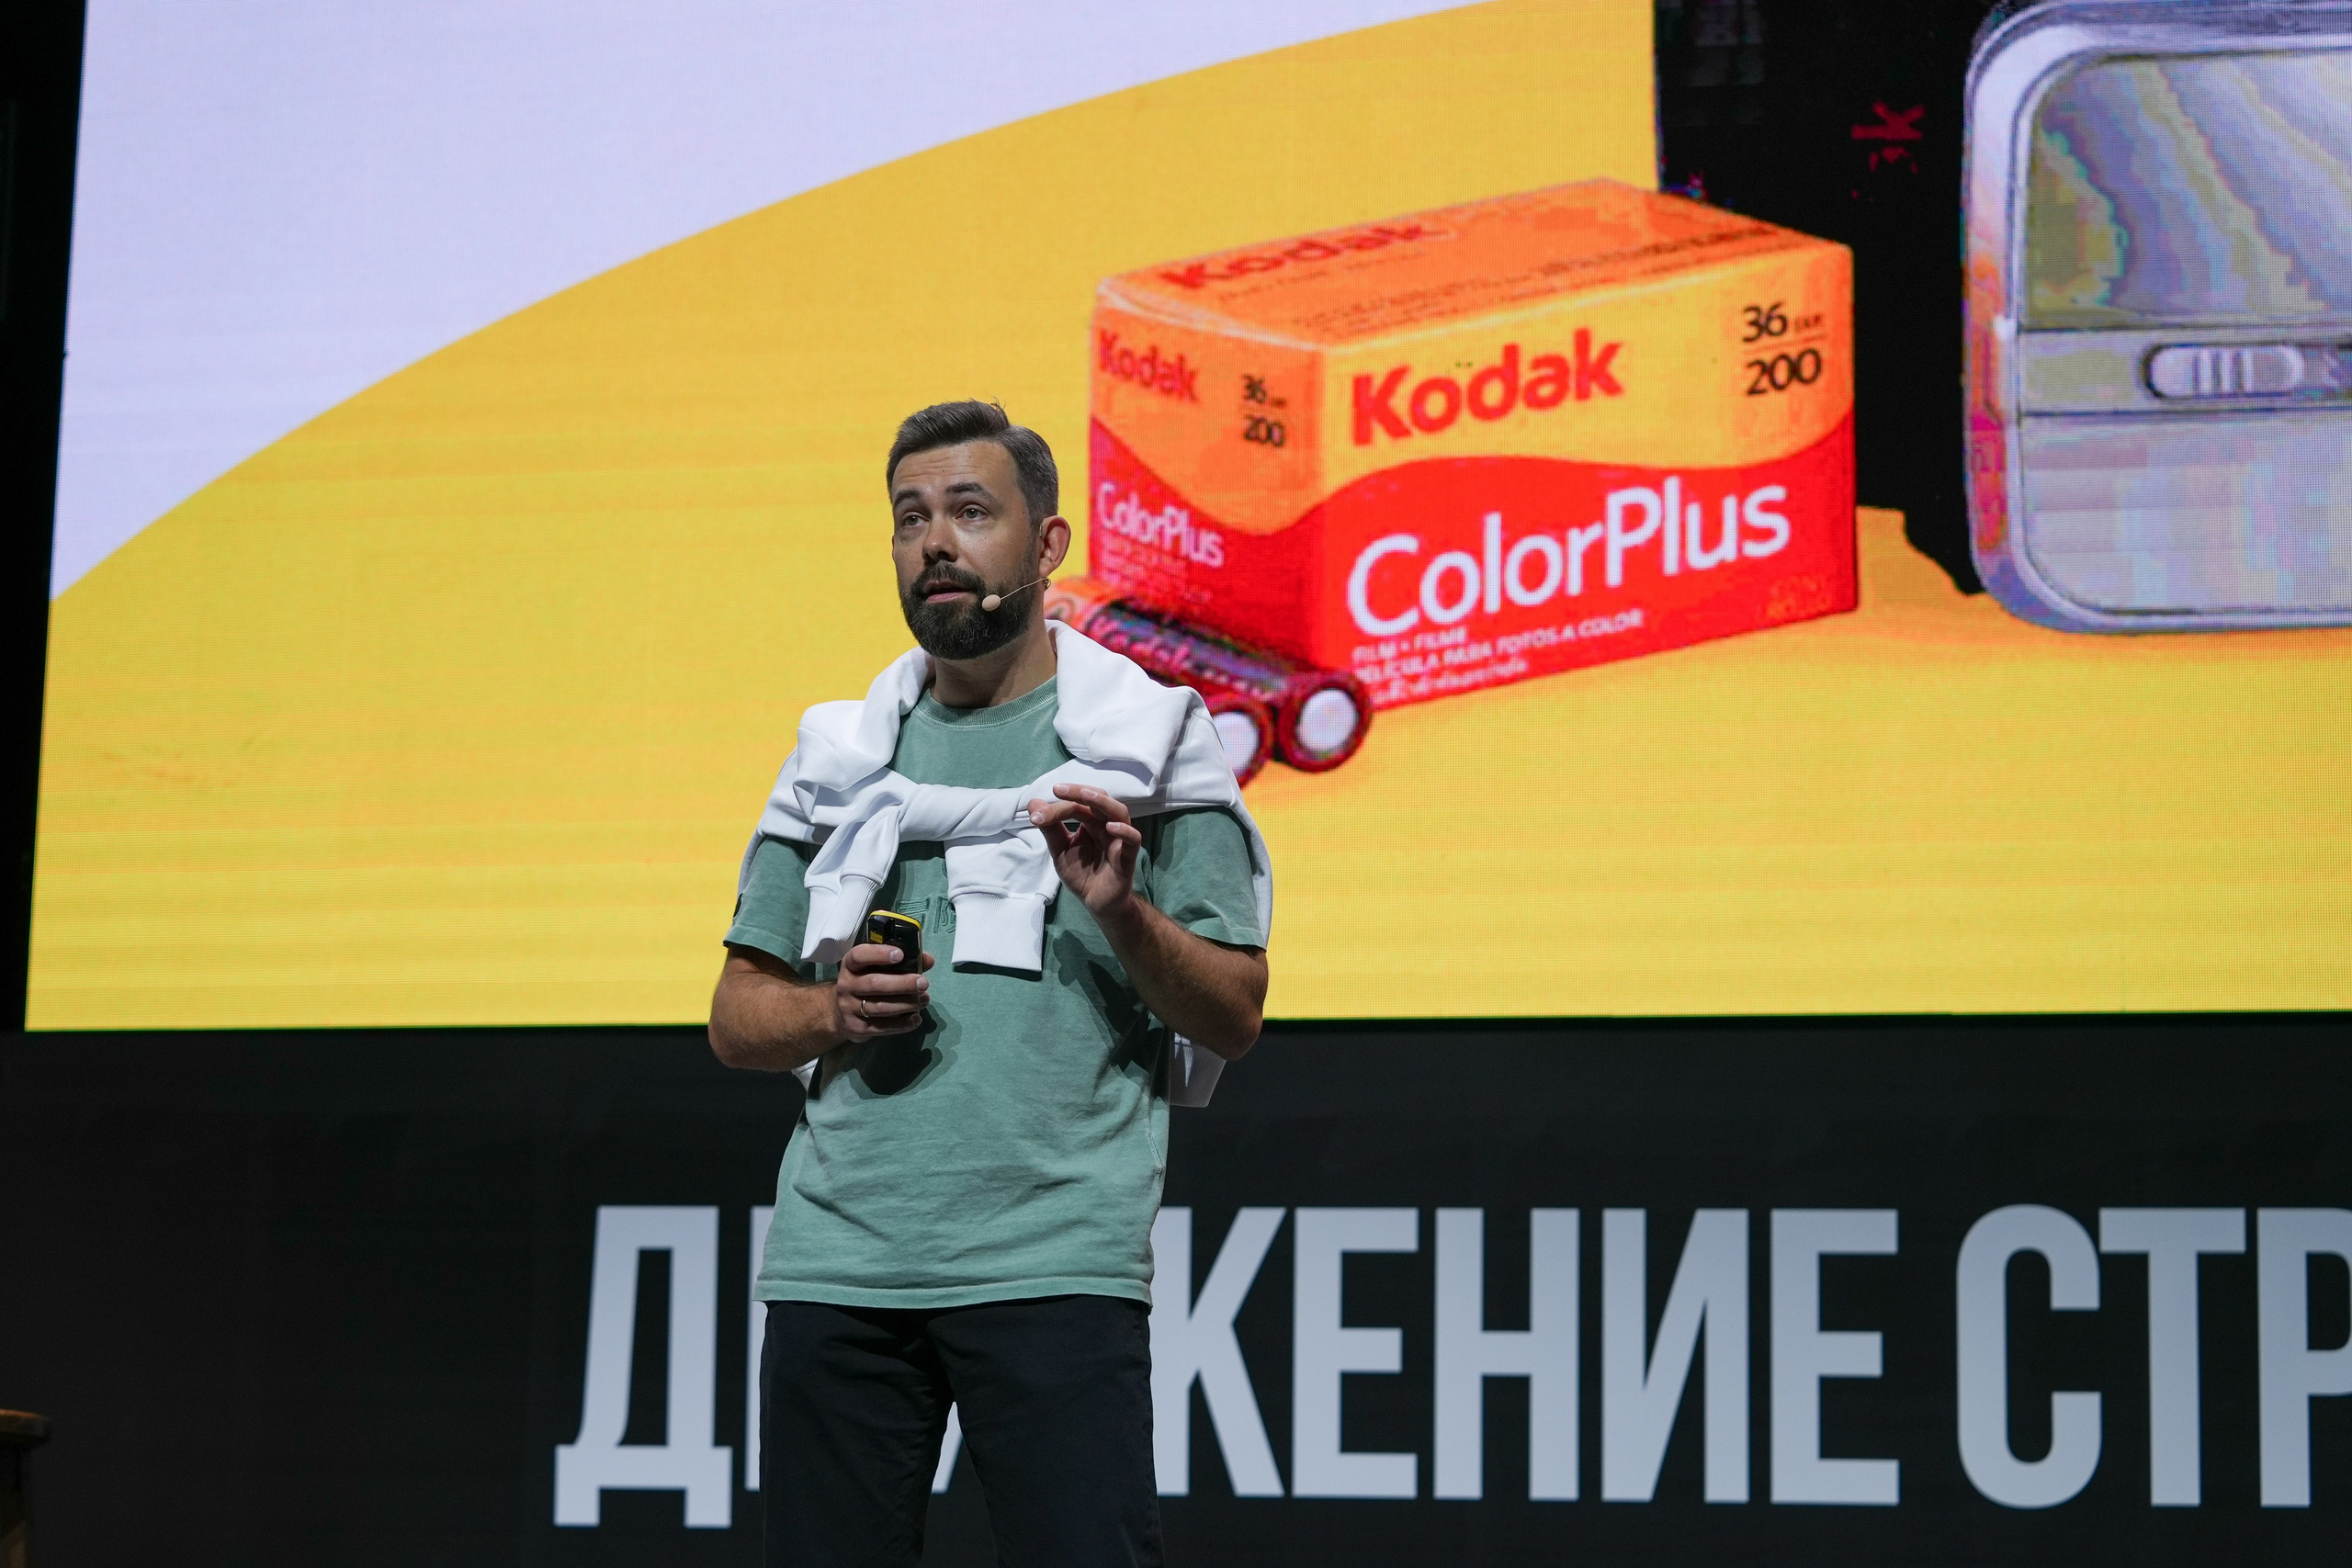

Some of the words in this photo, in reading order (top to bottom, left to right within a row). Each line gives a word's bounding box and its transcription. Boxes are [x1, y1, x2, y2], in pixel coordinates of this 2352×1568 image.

[1159, 223, 1448, 289] Kodak
[1741, 300, 1787, 344] 36
[1099, 328, 1199, 404] Kodak
[1242, 373, 1267, 404] 36
[1351, 327, 1625, 446] Kodak
[1746, 347, 1822, 395] 200
[1243, 414, 1285, 447] 200
[1096, 479, 1225, 568] ColorPlus
[1346, 475, 1792, 637] ColorPlus
[1352, 641, 1398, 665] FILM
[1413, 626, 1468, 649] FILME
[1496, 626, 1559, 654] FOTOS
[1577, 607, 1645, 637] COLOR
[554, 1205, 1900, 1528] ДЖЕНИЕ
[1956, 1203, 2352, 1510] СТР
